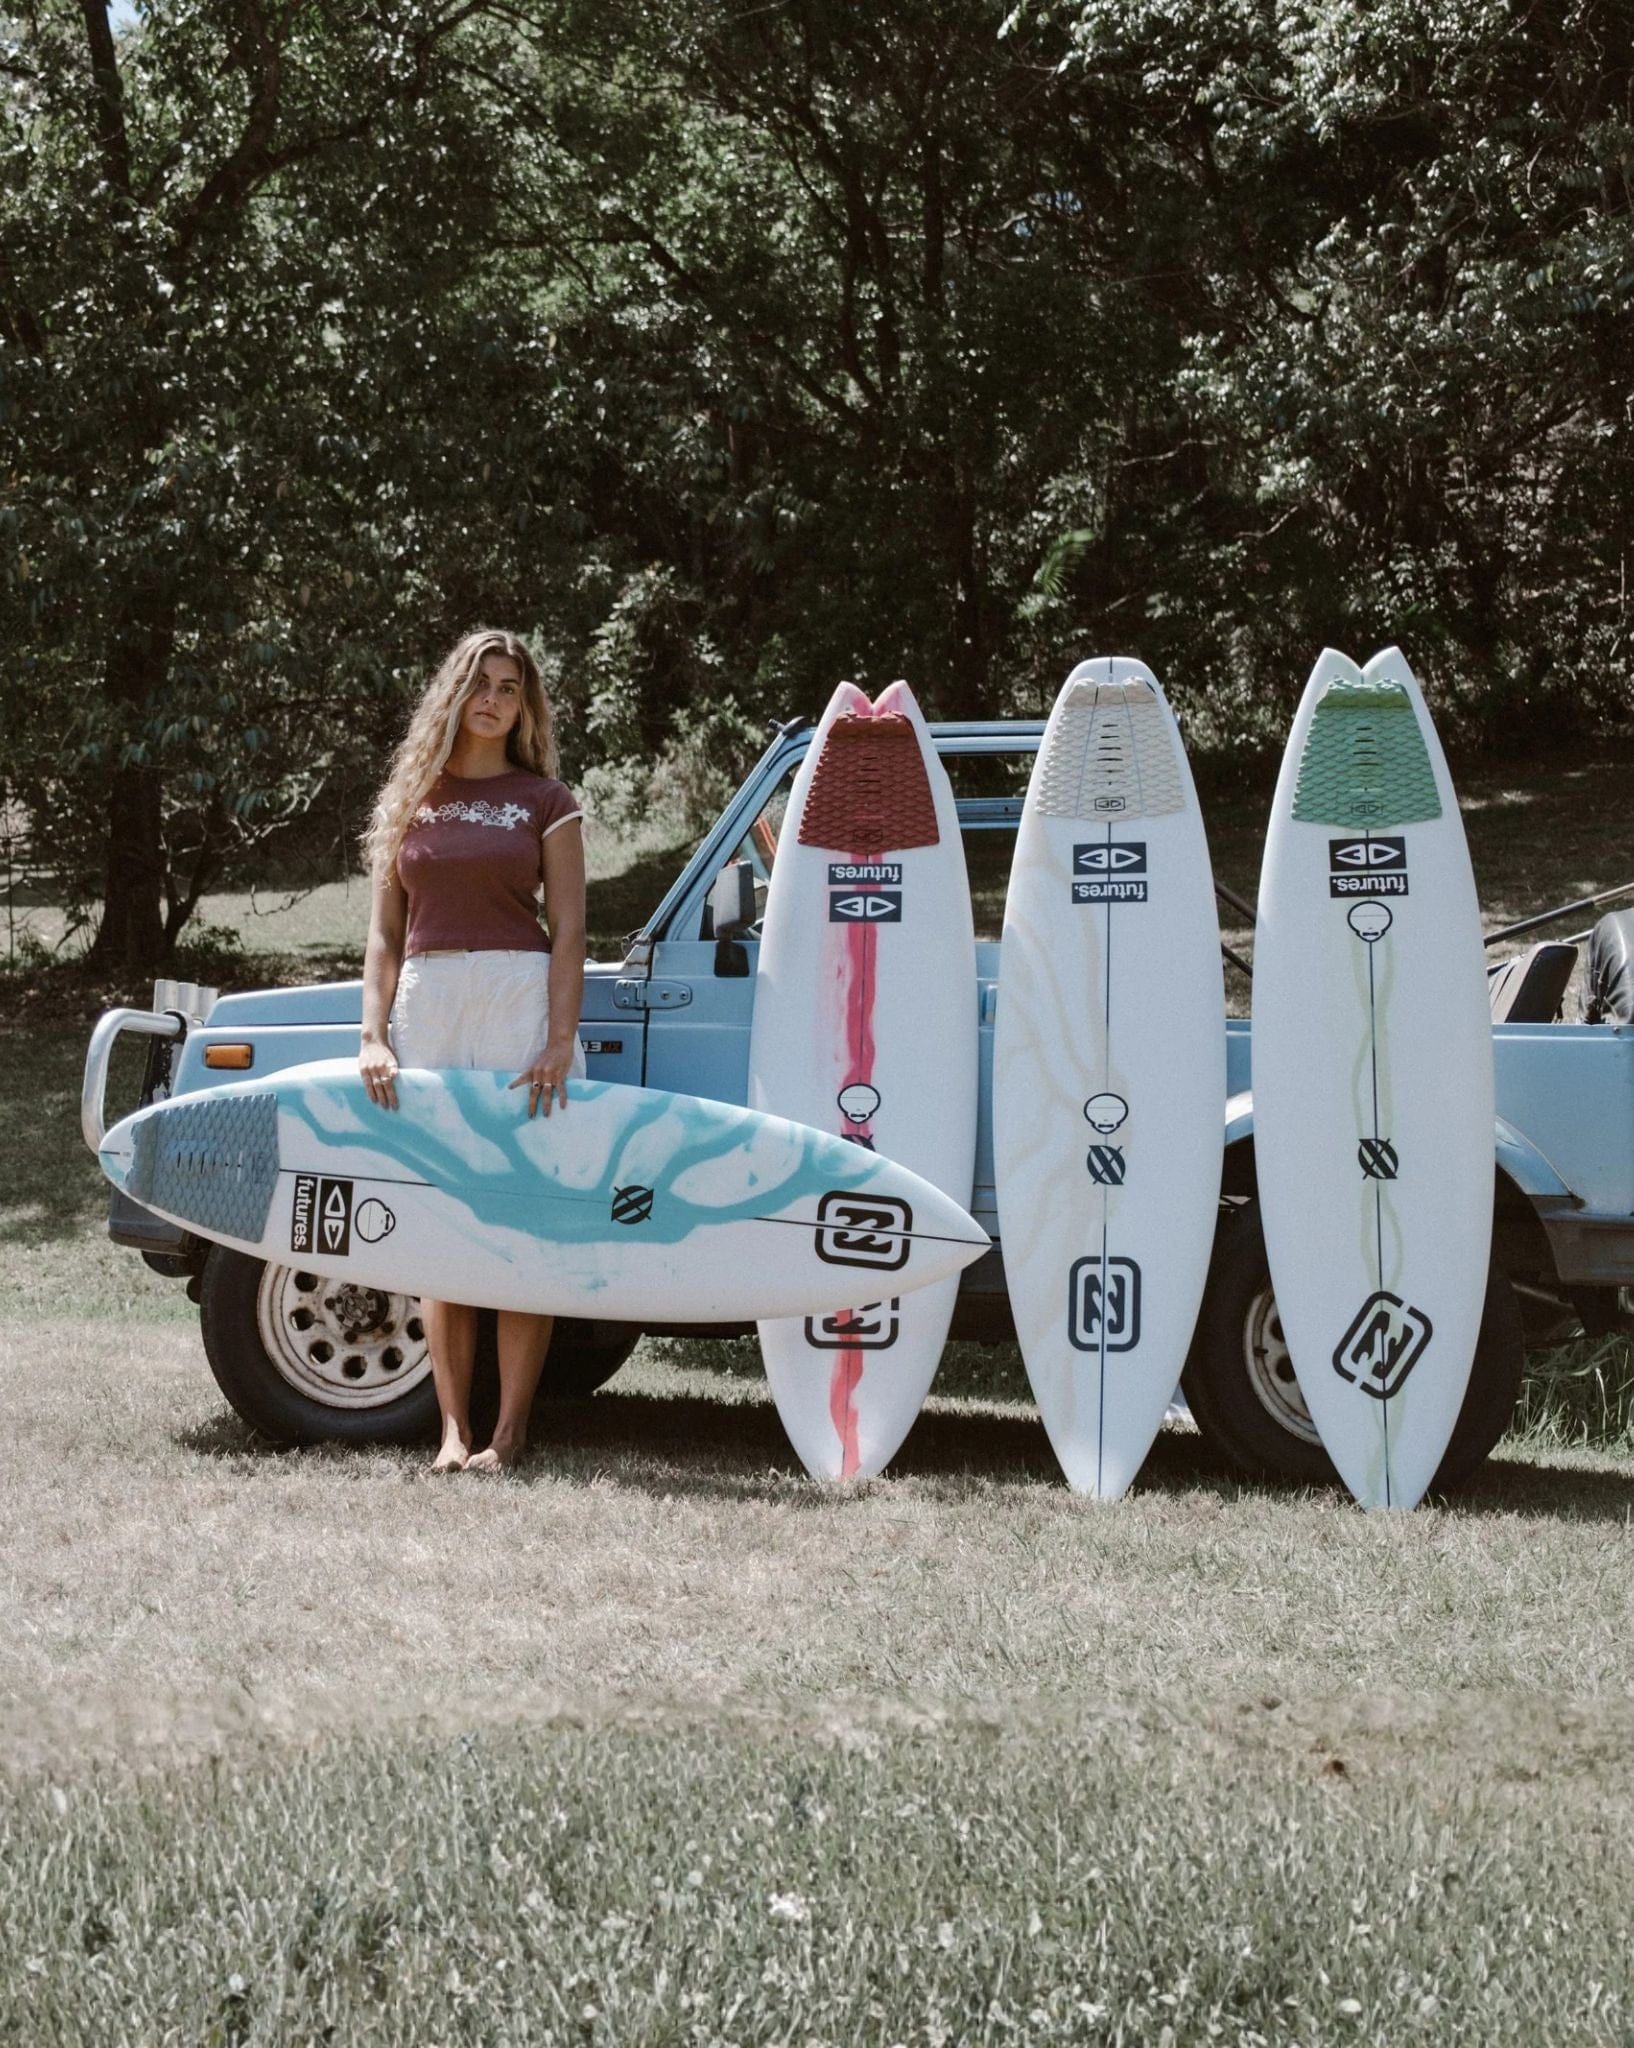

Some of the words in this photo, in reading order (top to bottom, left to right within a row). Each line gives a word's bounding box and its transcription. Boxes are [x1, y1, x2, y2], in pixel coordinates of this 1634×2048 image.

[830, 866, 900, 882] futures.
[1074, 883, 1145, 900] futures.
[1331, 876, 1406, 893] futures.
[293, 1178, 315, 1251] futures.
